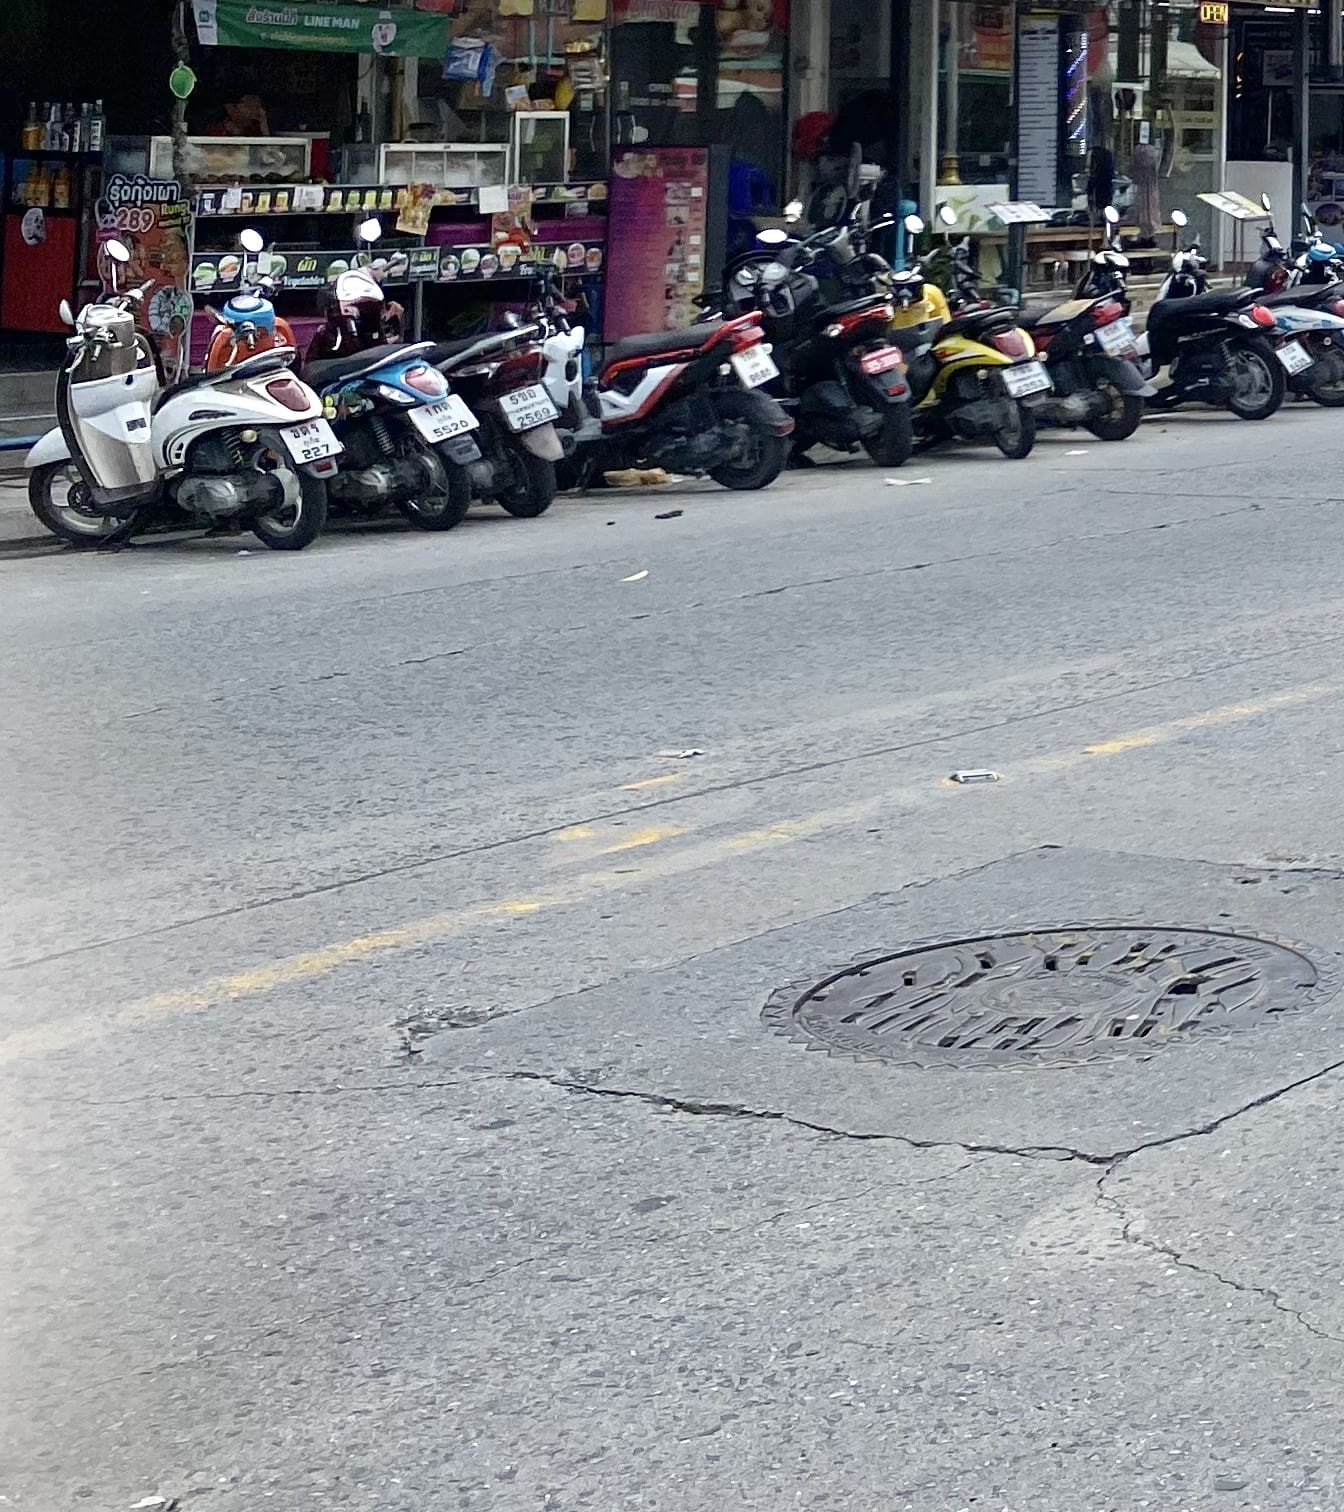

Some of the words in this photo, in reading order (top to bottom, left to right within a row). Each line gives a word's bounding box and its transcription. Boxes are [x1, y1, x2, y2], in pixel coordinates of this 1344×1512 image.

[1202, 5, 1227, 21] OPEN
[304, 15, 332, 29] LINE
[332, 16, 360, 30] MAN
[114, 206, 155, 233] 289
[516, 407, 551, 427] 2569
[433, 420, 470, 438] 5520
[301, 444, 331, 460] 227
